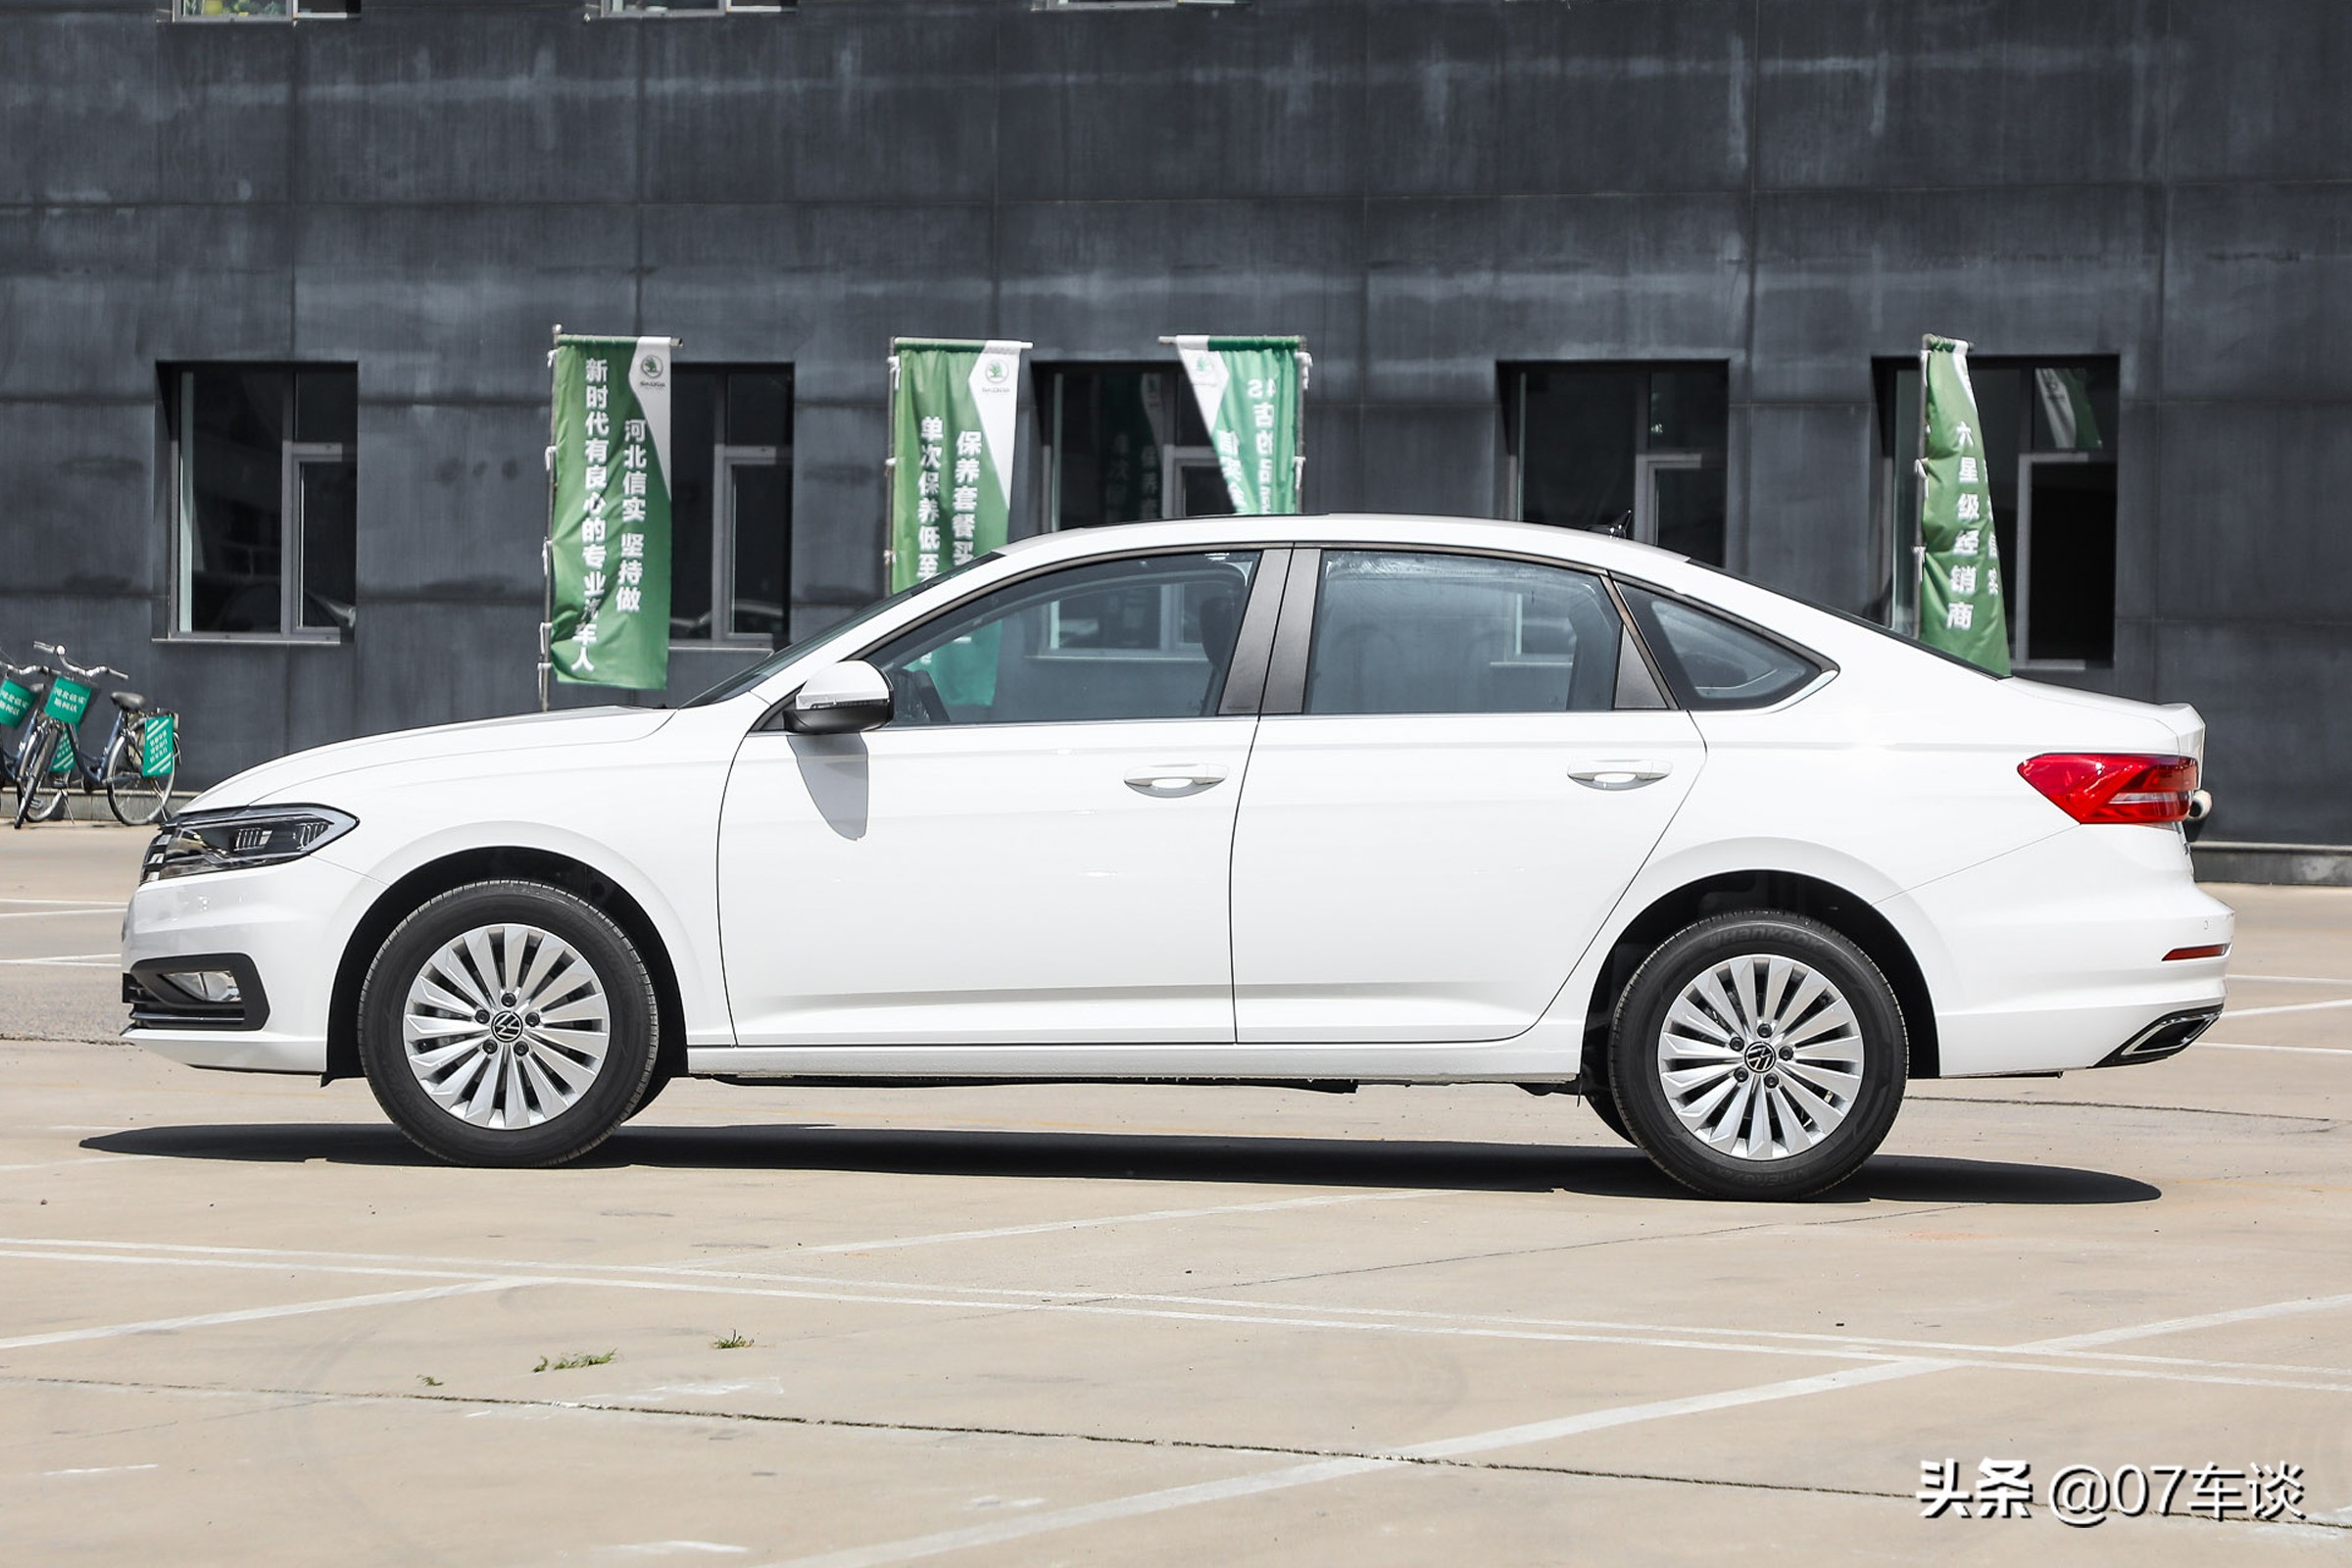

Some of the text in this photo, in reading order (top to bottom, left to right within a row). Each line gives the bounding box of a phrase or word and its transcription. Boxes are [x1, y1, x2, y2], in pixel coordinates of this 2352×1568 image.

[615, 418, 647, 612] 河北信实 坚持做
